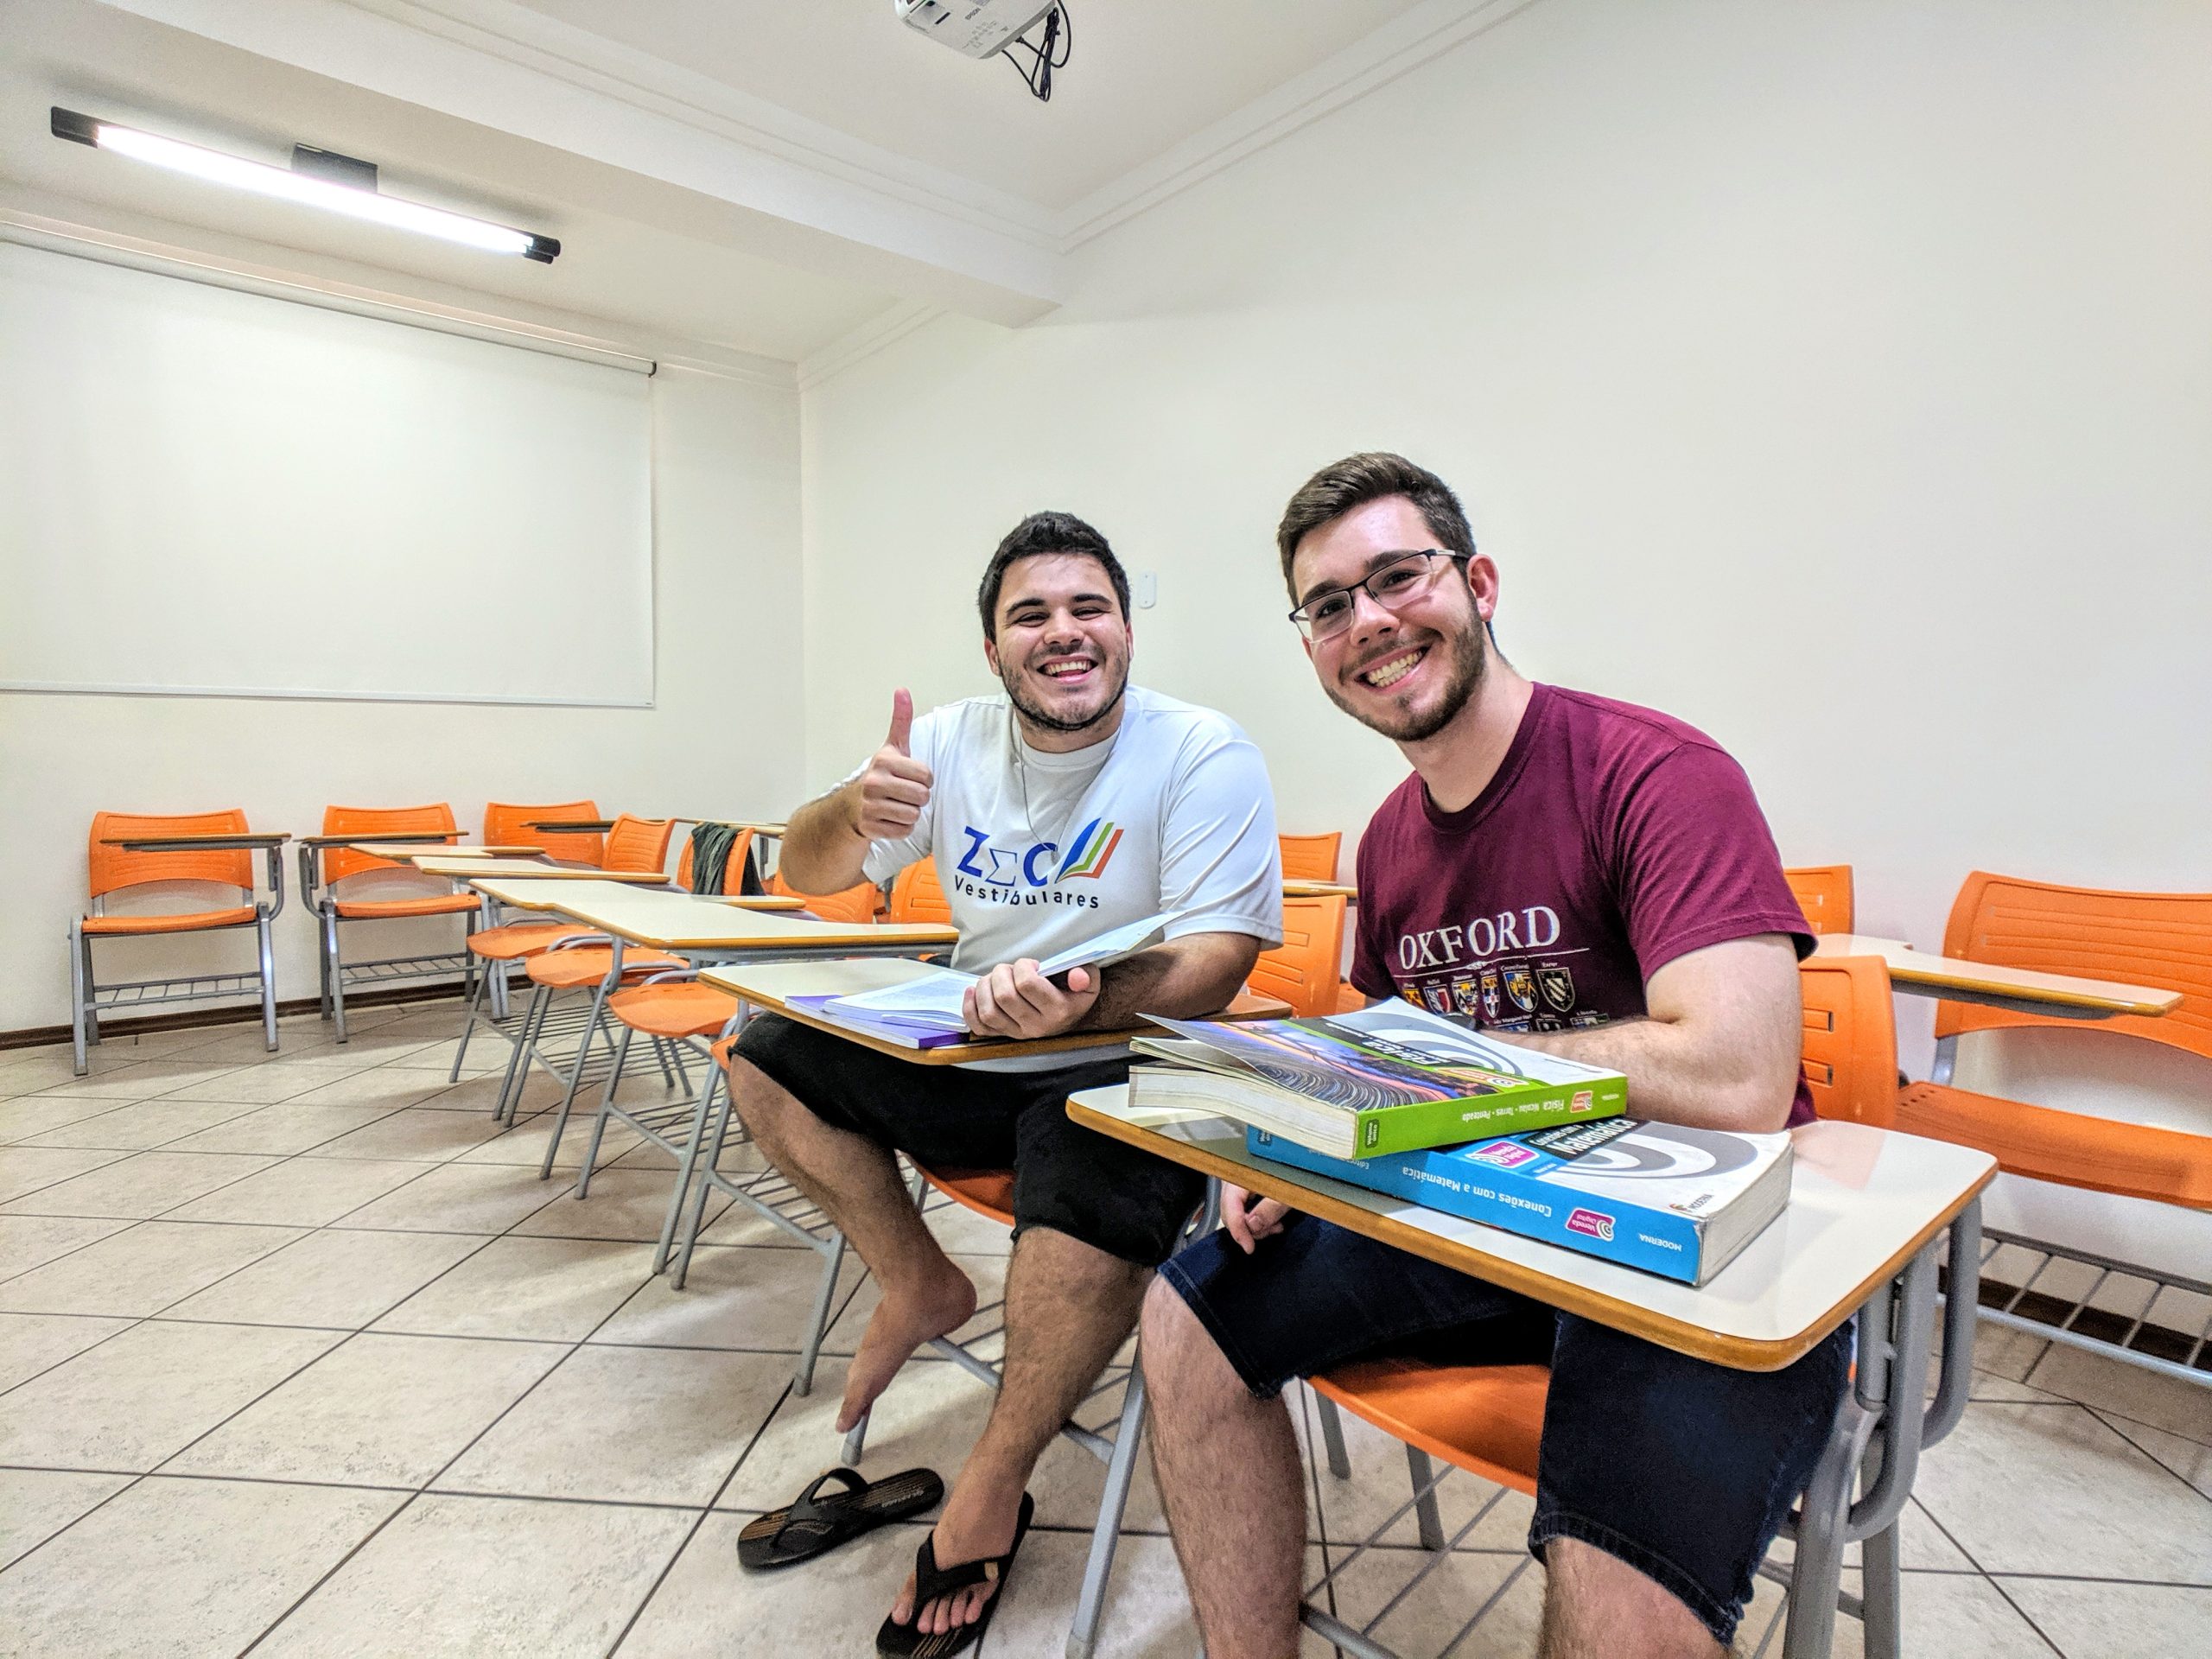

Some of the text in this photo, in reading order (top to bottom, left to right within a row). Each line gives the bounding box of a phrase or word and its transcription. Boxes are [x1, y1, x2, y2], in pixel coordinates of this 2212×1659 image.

[954, 874, 1099, 908] Vestibulares
[1399, 906, 1560, 969] OXFORD
[1496, 1106, 1515, 1116] Torres
[1543, 1099, 1565, 1110] Física
[1462, 1110, 1491, 1122] Penteado
[1546, 1118, 1638, 1154] Matemática
[1402, 1166, 1552, 1217] Conexões com a Matemática
[1572, 1219, 1596, 1232] Vereda
[1638, 1233, 1682, 1252] MODERNA
